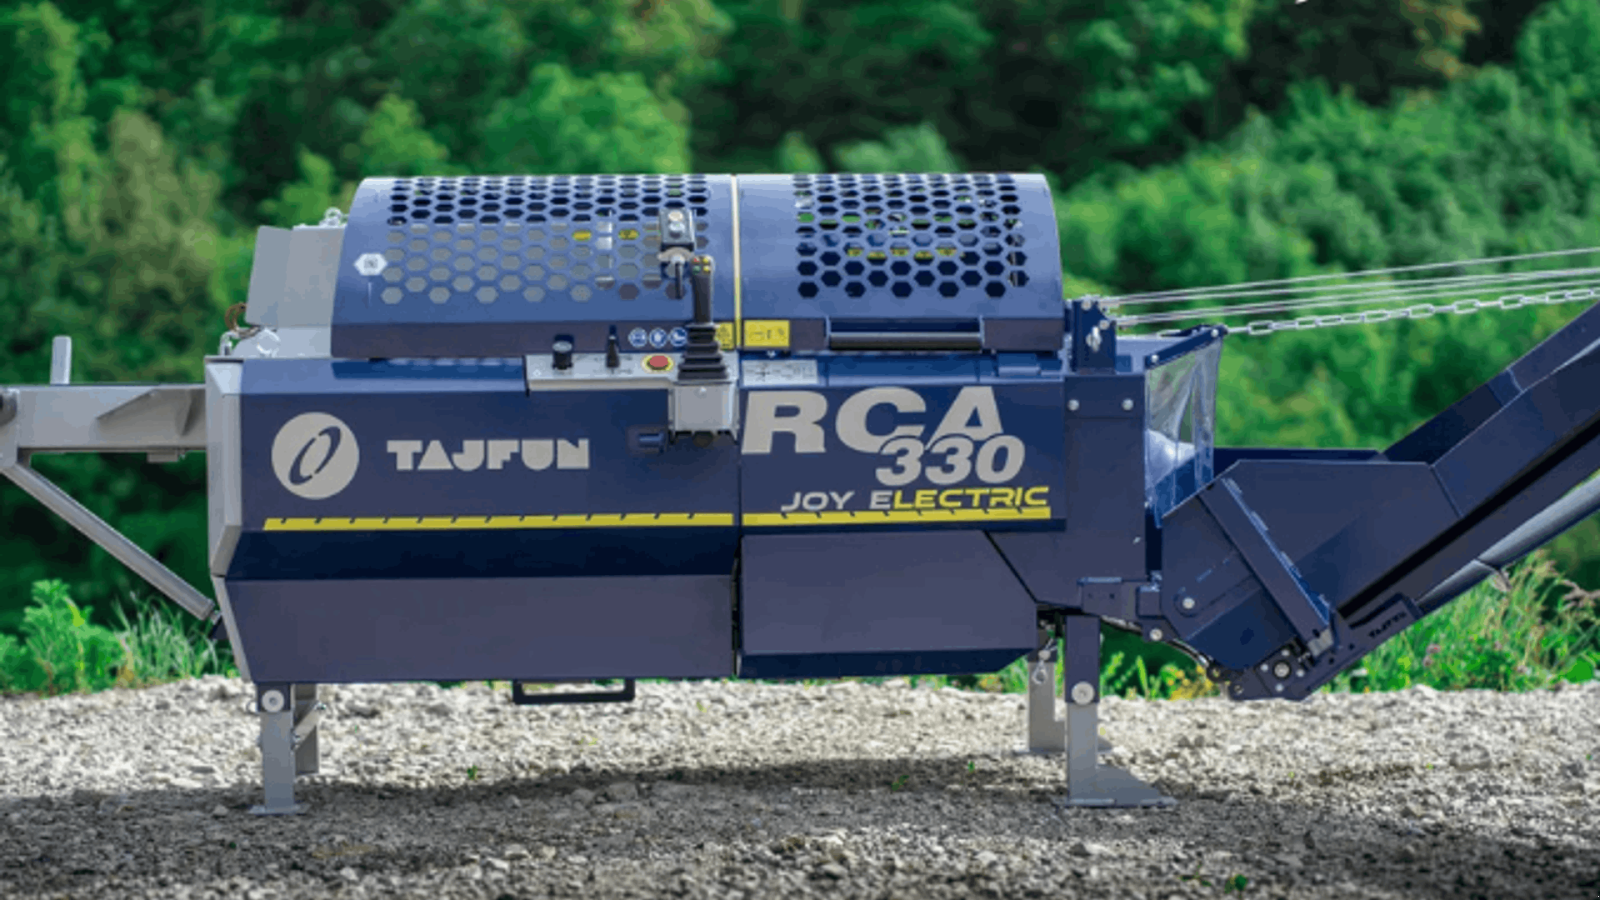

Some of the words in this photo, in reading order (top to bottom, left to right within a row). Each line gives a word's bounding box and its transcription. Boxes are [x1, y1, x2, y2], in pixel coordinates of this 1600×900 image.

[741, 386, 1003, 454] RCA
[386, 438, 590, 471] TAJFUN
[875, 434, 1026, 487] 330
[781, 491, 855, 512] JOY
[869, 486, 1050, 510] ELECTRIC
